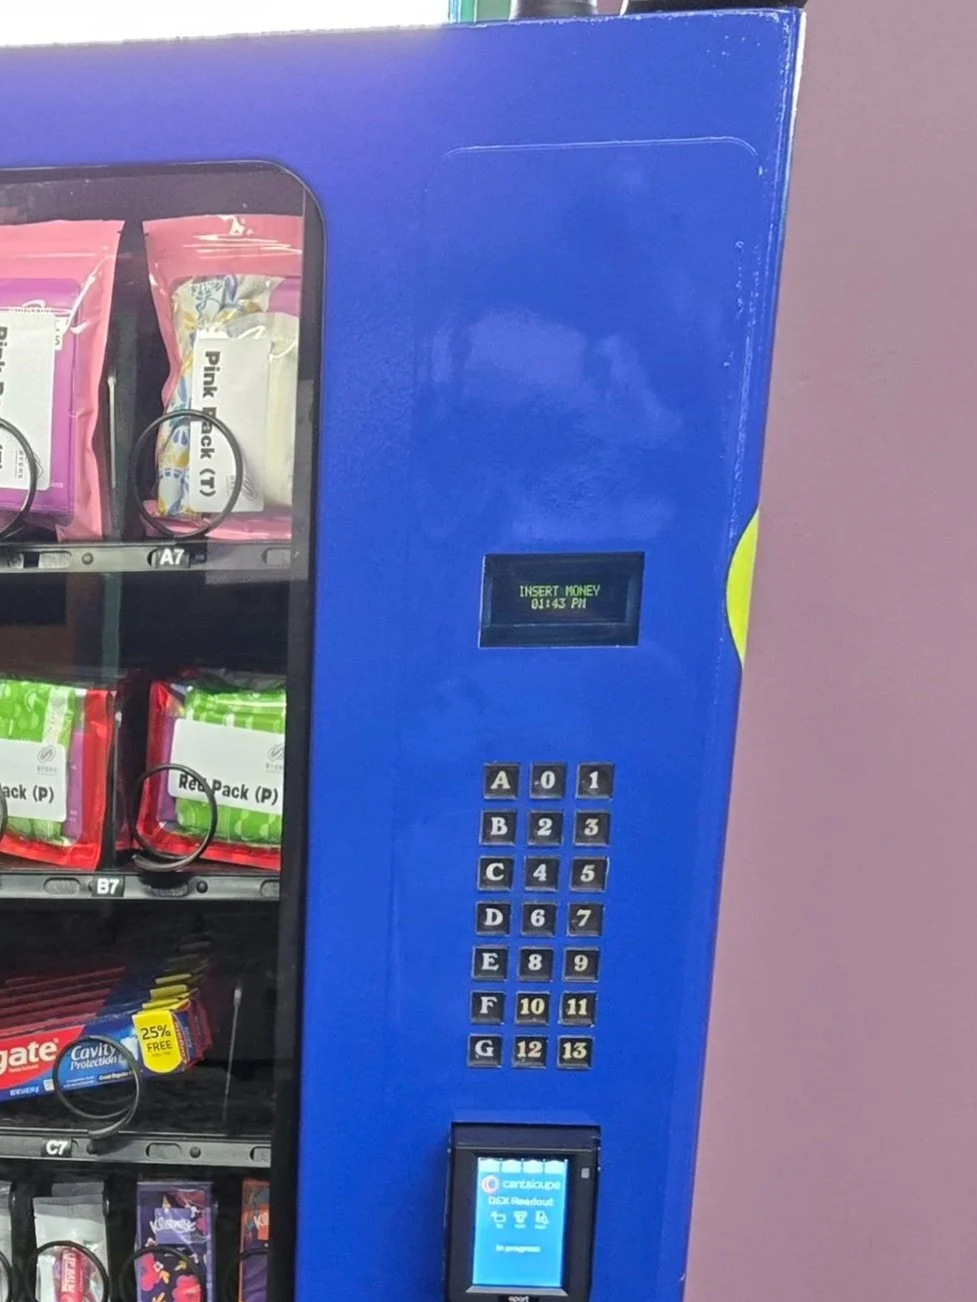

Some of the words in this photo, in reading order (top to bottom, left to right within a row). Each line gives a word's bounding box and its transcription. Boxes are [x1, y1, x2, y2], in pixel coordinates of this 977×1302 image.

[201, 351, 221, 399] Pink
[198, 468, 216, 498] (T)
[159, 549, 185, 566] A7
[519, 584, 560, 598] INSERT
[565, 584, 600, 597] MONEY
[530, 597, 566, 609] 01:43
[570, 597, 587, 609] PM
[490, 770, 511, 790] A
[540, 770, 555, 790] 0
[588, 770, 600, 790] 1
[33, 784, 54, 804] (P)
[212, 778, 249, 801] Pack
[255, 785, 279, 806] (P)
[490, 817, 508, 836] B
[537, 817, 553, 836] 2
[584, 818, 599, 836] 3
[485, 862, 505, 882] C
[533, 863, 547, 882] 4
[580, 864, 596, 882] 5
[96, 878, 120, 895] B7
[484, 909, 503, 927] D
[530, 909, 546, 927] 6
[576, 909, 592, 927] 7
[481, 953, 499, 971] E
[527, 954, 543, 971] 8
[574, 954, 589, 972] 9
[479, 996, 498, 1015] F
[519, 997, 545, 1015] 10
[566, 998, 588, 1016] 11
[140, 1024, 171, 1041] 25%
[70, 1041, 117, 1061] Cavity
[146, 1040, 173, 1054] FREE
[474, 1039, 494, 1058] G
[517, 1041, 542, 1059] 12
[562, 1041, 588, 1059] 13
[70, 1054, 117, 1071] Protection
[45, 1139, 68, 1155] C7
